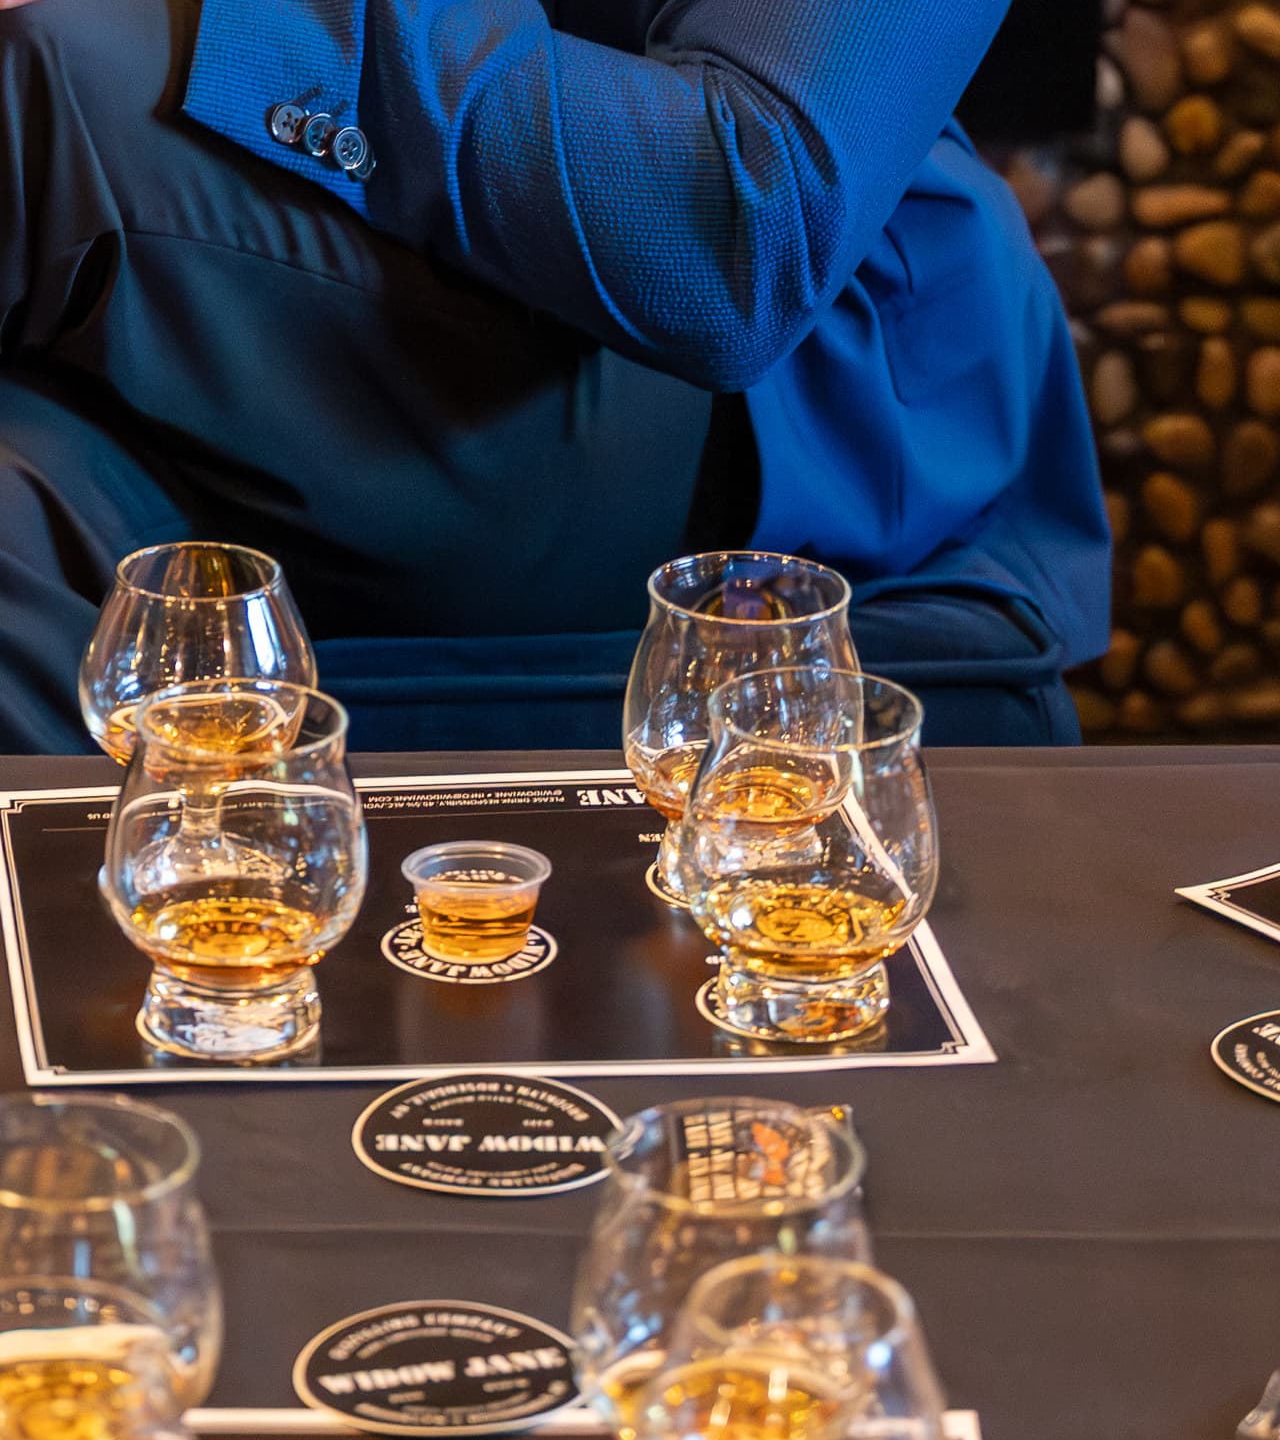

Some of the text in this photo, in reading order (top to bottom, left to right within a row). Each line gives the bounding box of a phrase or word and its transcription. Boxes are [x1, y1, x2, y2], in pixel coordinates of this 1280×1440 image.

[531, 796, 565, 804] PLEASE
[375, 1133, 608, 1153] WIDOW JANE
[317, 1345, 568, 1396] WIDOW JANE
